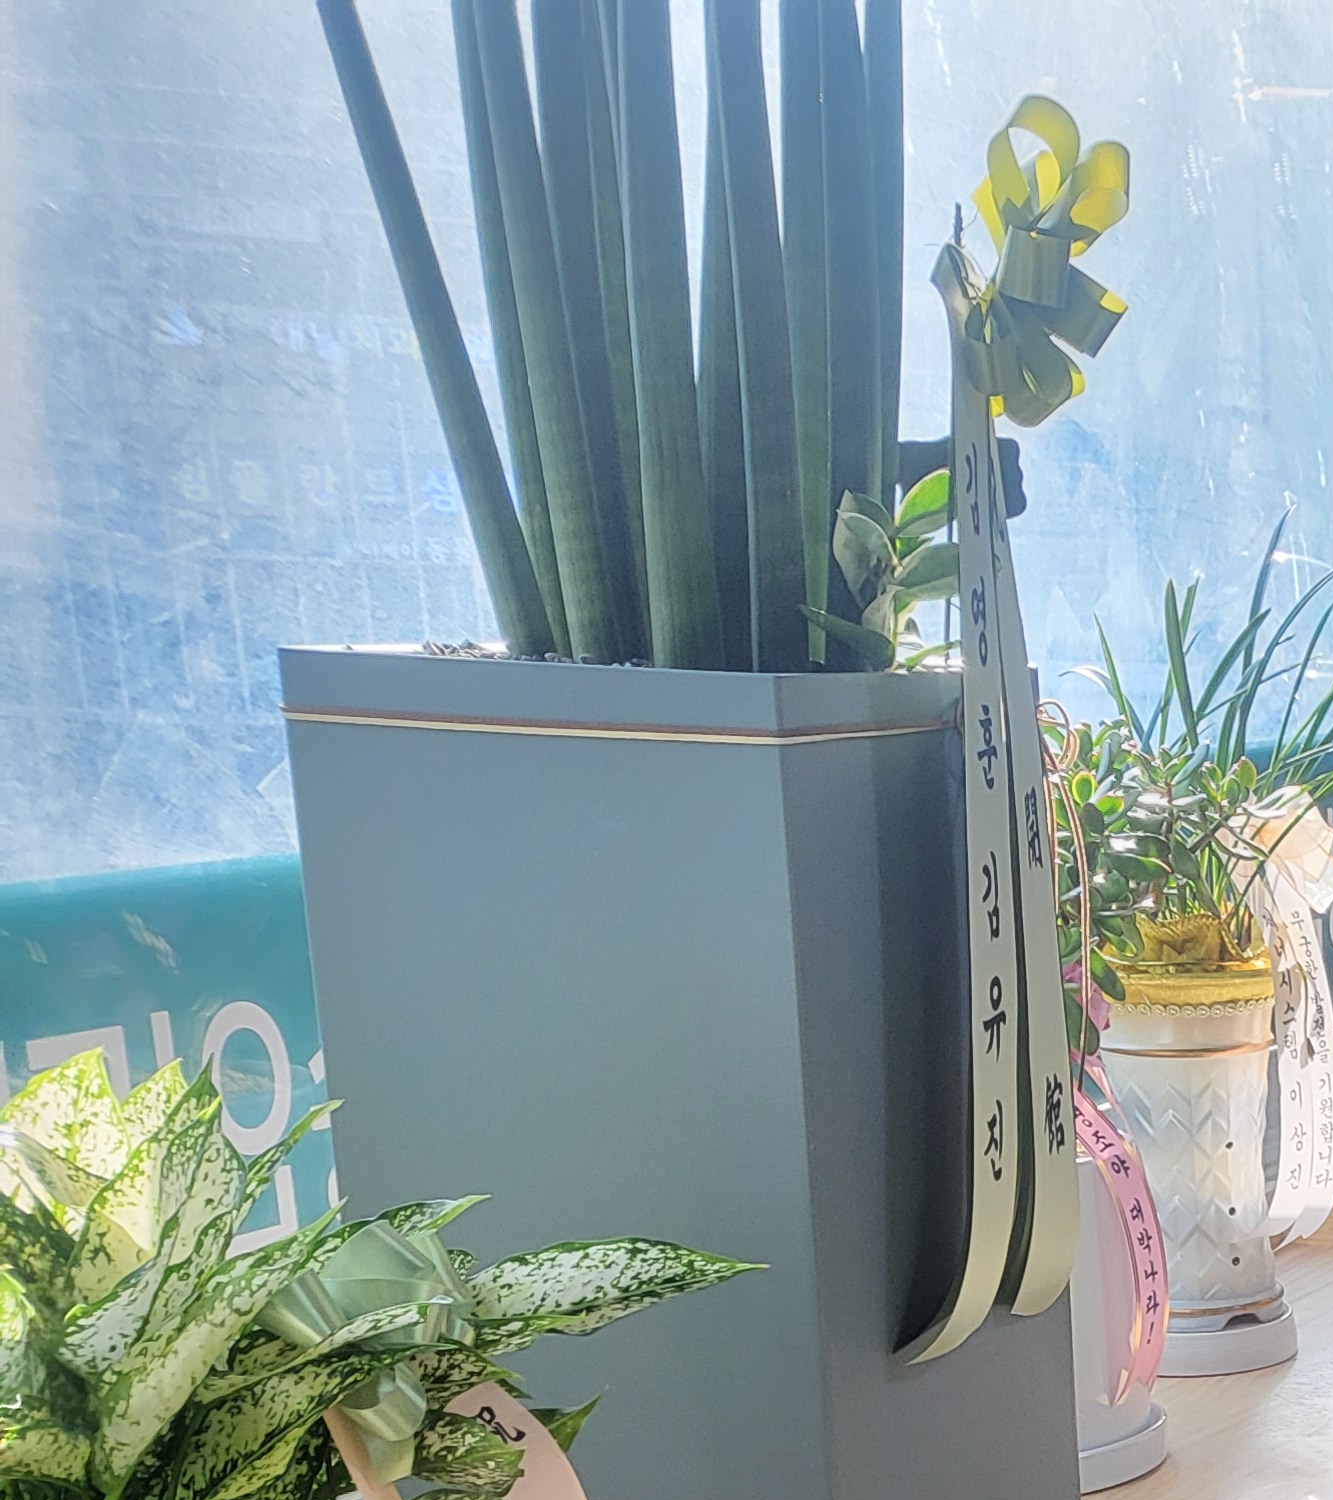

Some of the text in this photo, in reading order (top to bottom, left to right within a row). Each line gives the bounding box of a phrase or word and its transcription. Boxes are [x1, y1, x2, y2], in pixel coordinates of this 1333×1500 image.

[965, 442, 1007, 1182] 김영훈 김유진
[1290, 909, 1319, 983] 무궁한
[1310, 992, 1331, 1063] 발전을
[1286, 1080, 1308, 1191] 이상진
[1129, 1197, 1160, 1346] 대박나라!
